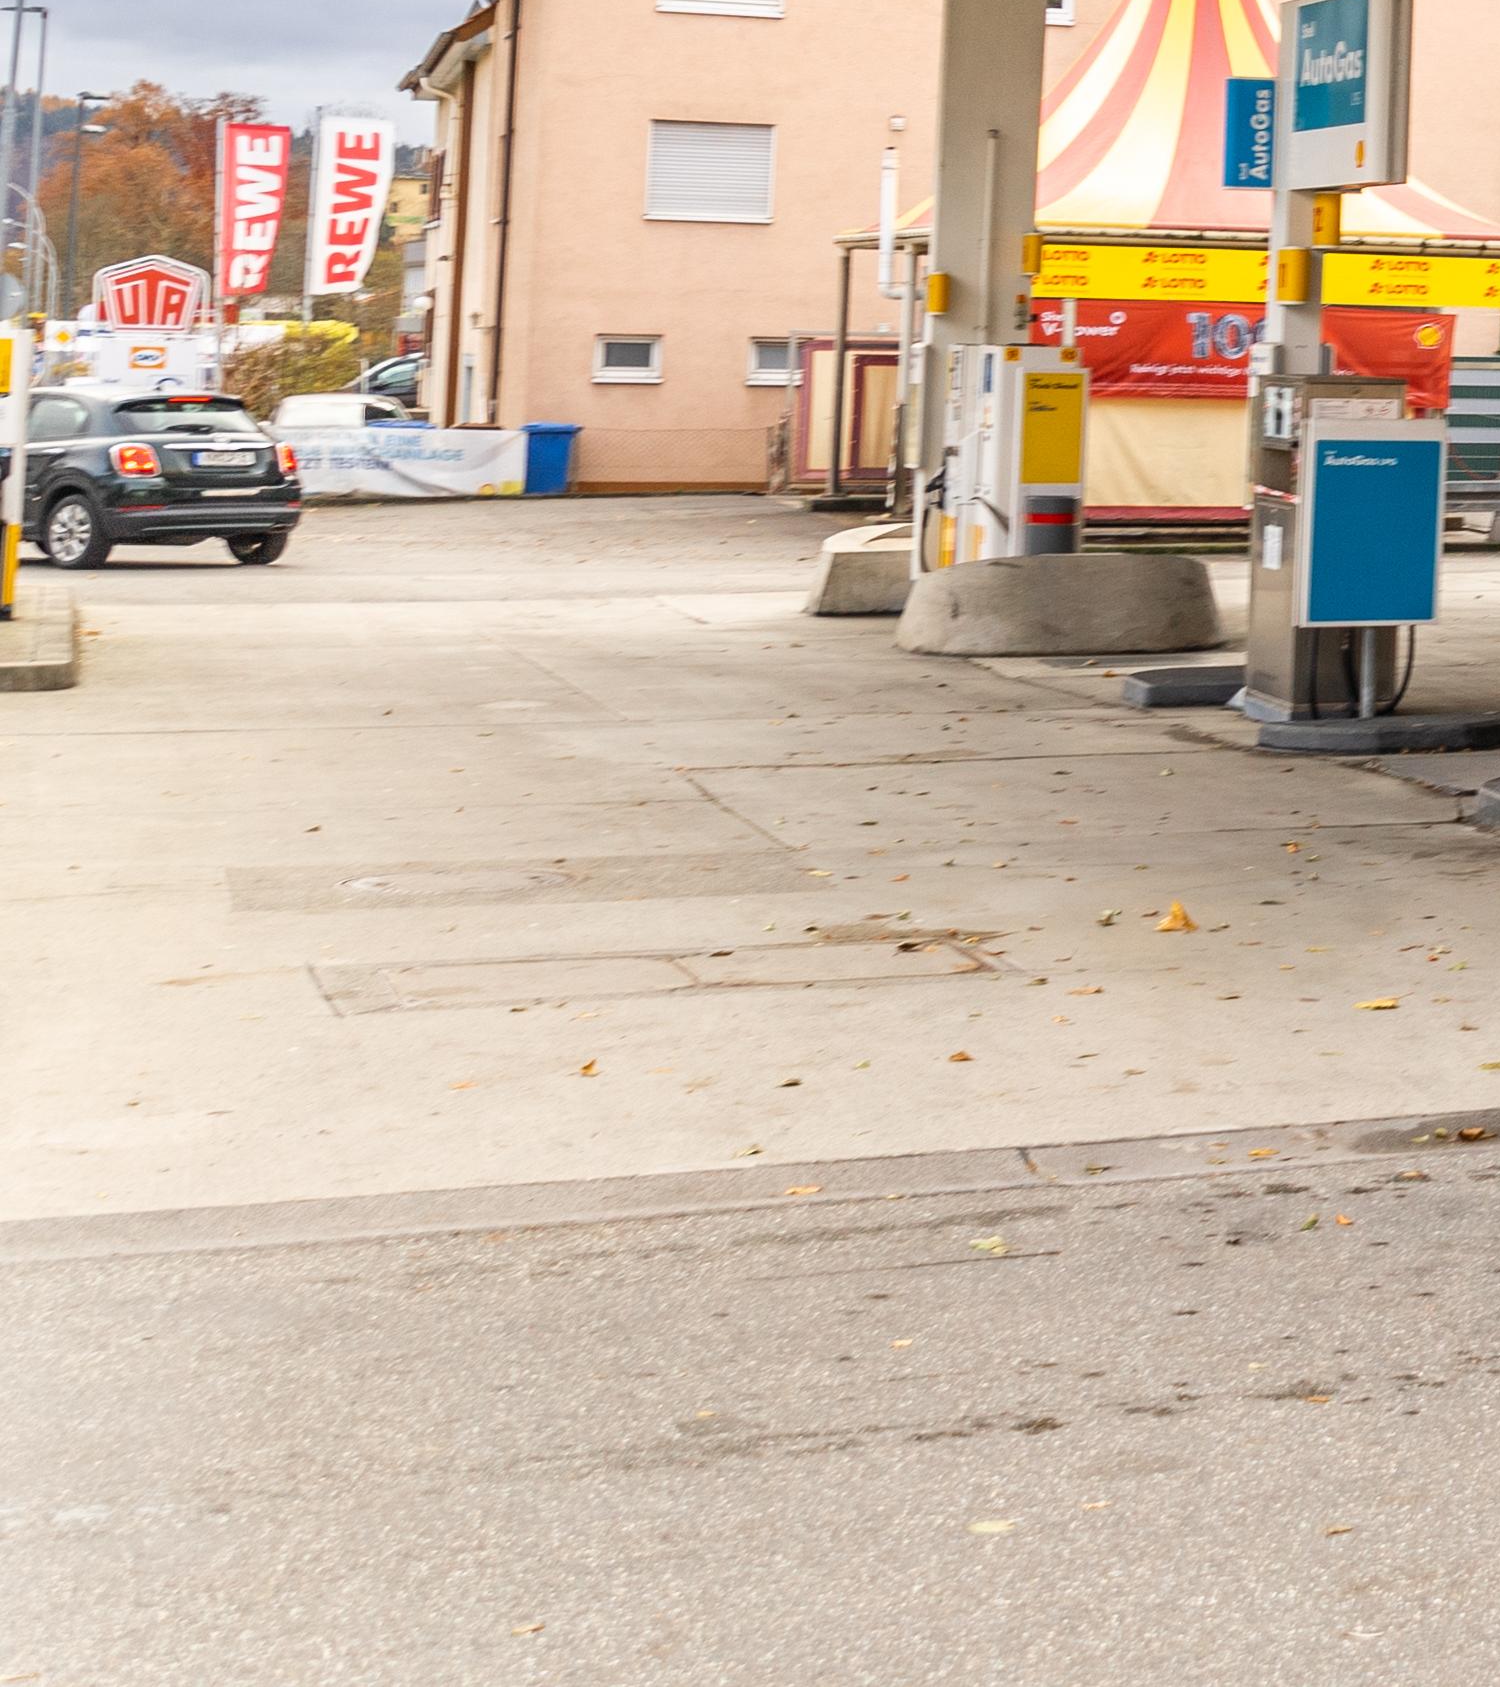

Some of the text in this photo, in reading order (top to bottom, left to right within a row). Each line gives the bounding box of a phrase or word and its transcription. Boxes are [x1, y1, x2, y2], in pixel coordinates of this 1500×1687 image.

[1300, 41, 1364, 87] AutoGas
[1249, 89, 1272, 180] AutoGas
[228, 135, 283, 288] REWE
[325, 131, 381, 285] REWE
[106, 265, 196, 330] UTA
[1041, 323, 1120, 336] V-ower
